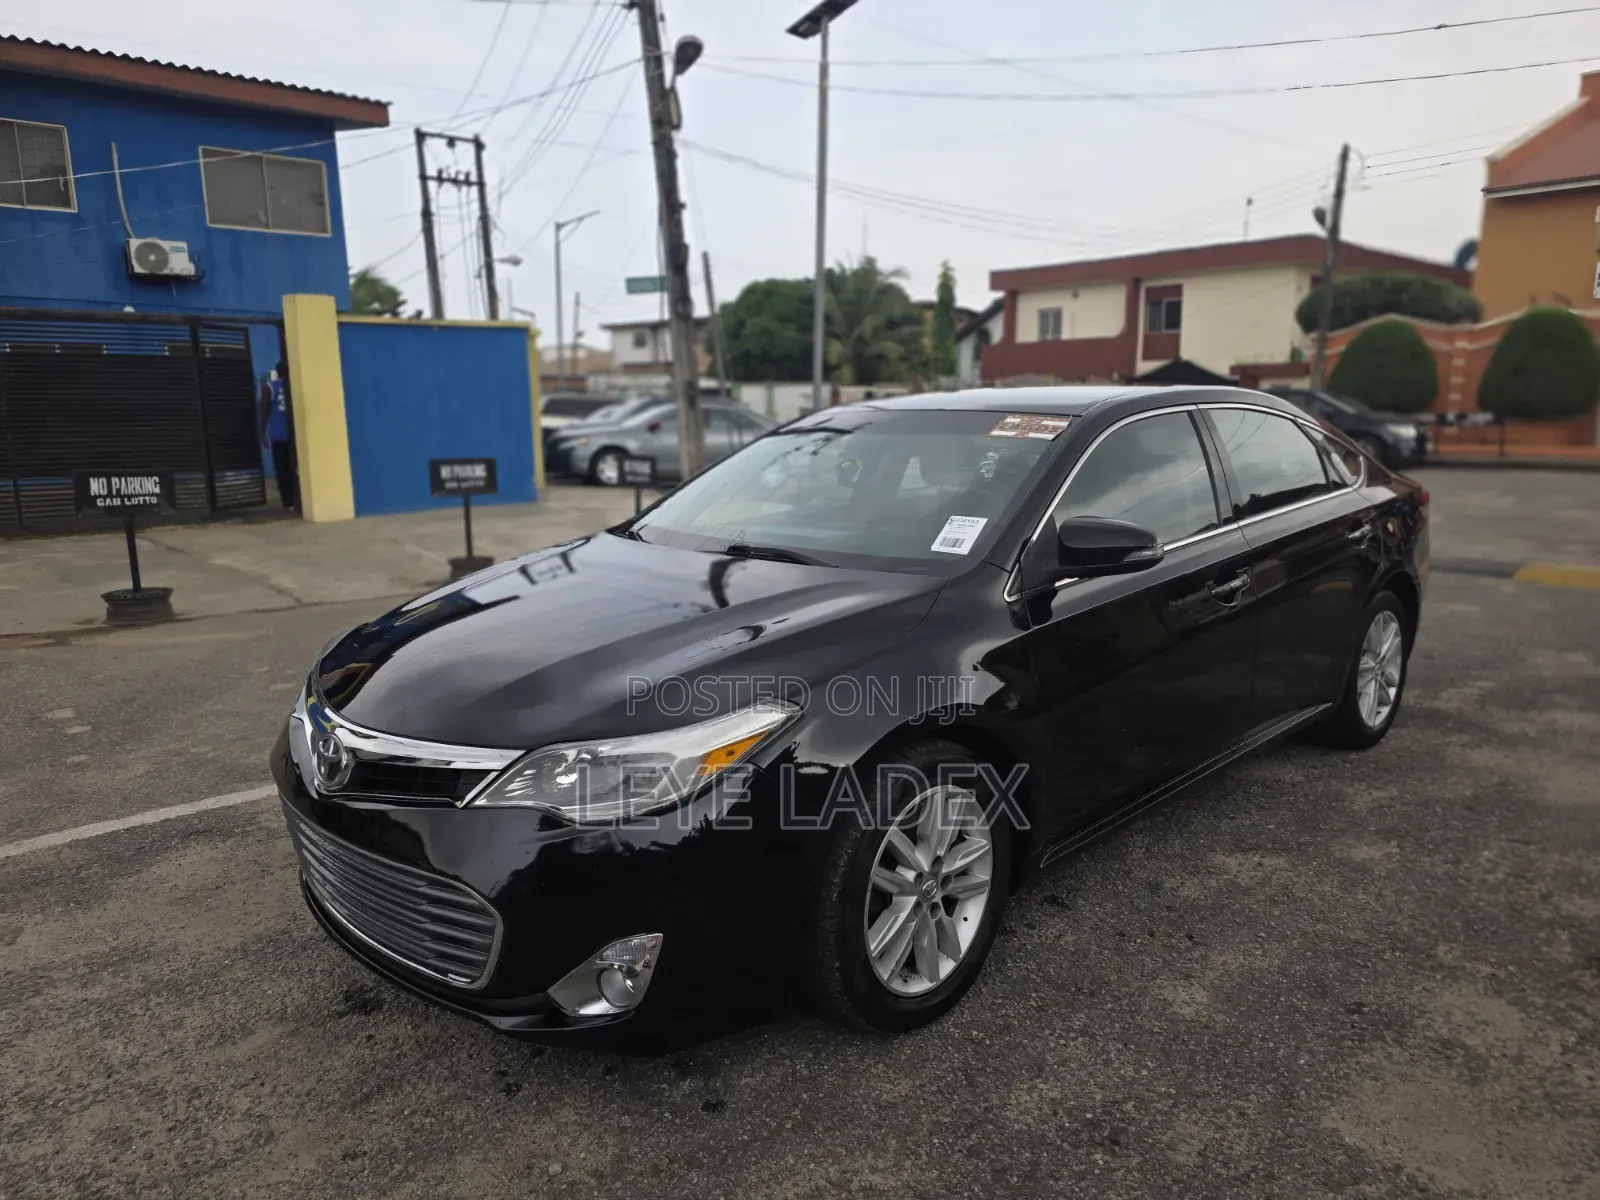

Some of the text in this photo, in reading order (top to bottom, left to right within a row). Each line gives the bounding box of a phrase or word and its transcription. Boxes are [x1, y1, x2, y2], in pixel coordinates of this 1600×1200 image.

[89, 476, 160, 496] NO PARKING
[124, 496, 158, 506] LOTTO
